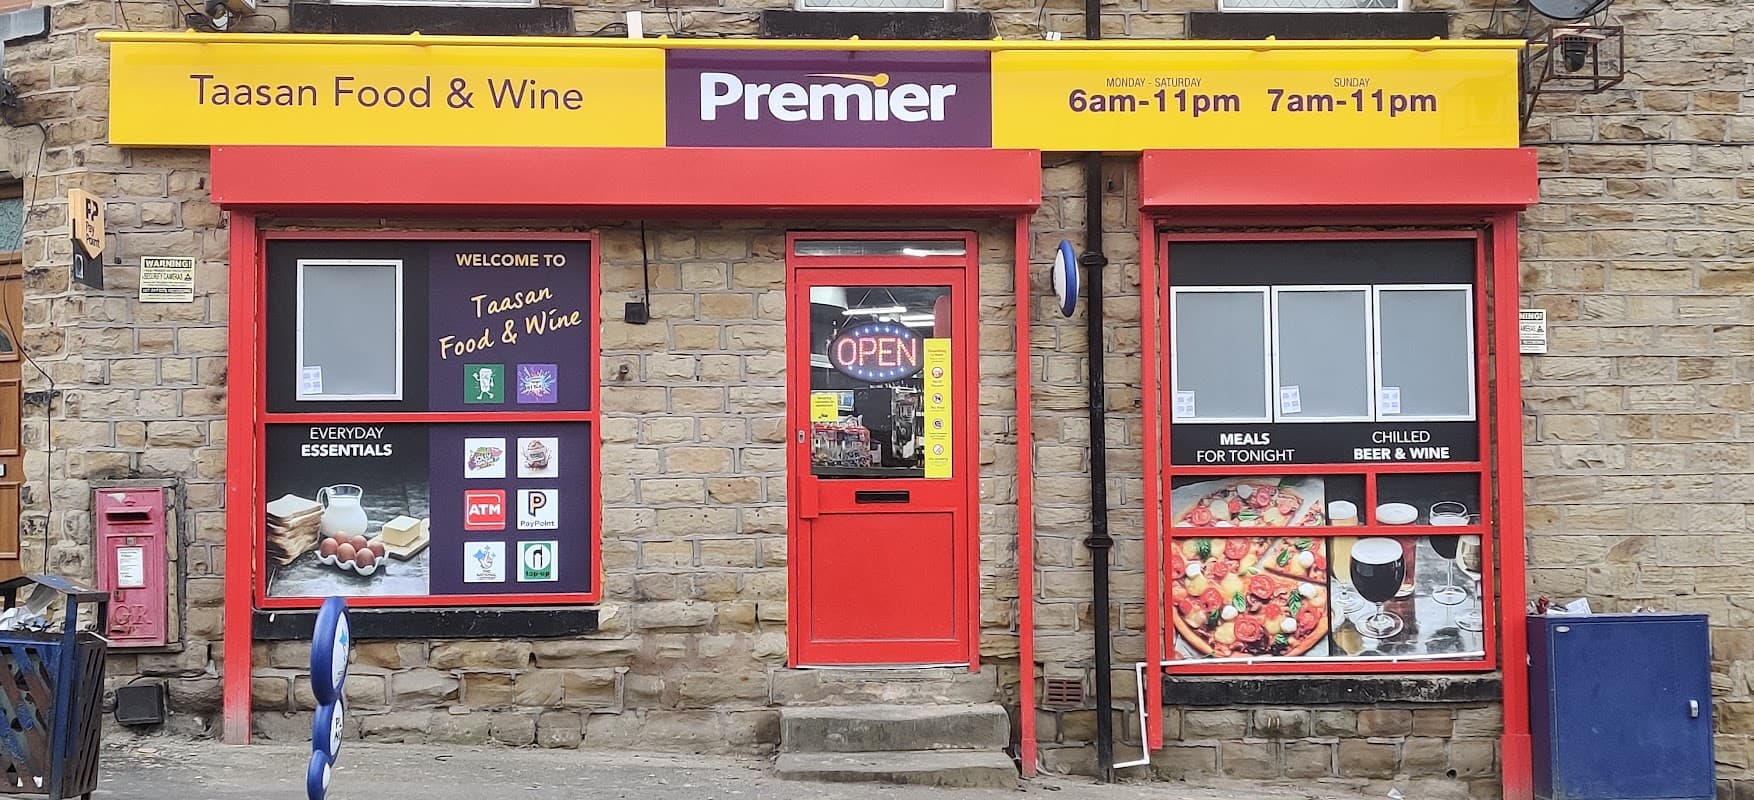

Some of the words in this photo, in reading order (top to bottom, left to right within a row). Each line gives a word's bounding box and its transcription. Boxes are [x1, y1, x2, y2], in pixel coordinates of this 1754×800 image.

[1106, 77, 1146, 88] MONDAY
[1154, 77, 1202, 88] SATURDAY
[1333, 77, 1370, 88] SUNDAY
[190, 75, 317, 106] Taasan
[335, 76, 431, 108] Food
[447, 78, 475, 109] &
[488, 79, 583, 110] Wine
[700, 73, 957, 122] Premier
[1068, 89, 1241, 117] 6am-11pm
[1266, 88, 1438, 117] 7am-11pm
[145, 259, 191, 268] WARNING!
[456, 253, 539, 267] WELCOME
[544, 254, 566, 267] TO
[471, 287, 553, 318] Taasan
[439, 328, 495, 360] Food
[501, 319, 518, 345] &
[525, 308, 582, 336] Wine
[836, 337, 917, 367] OPEN
[310, 426, 385, 439] EVERYDAY
[1220, 432, 1270, 446] MEALS
[1372, 430, 1431, 444] CHILLED
[301, 443, 393, 457] ESSENTIALS
[1197, 449, 1226, 463] FOR
[1229, 449, 1296, 463] TONIGHT
[1354, 447, 1391, 460] BEER
[1395, 447, 1406, 460] &
[1410, 446, 1450, 460] WINE
[468, 503, 501, 516] ATM
[520, 519, 555, 528] PayPoint
